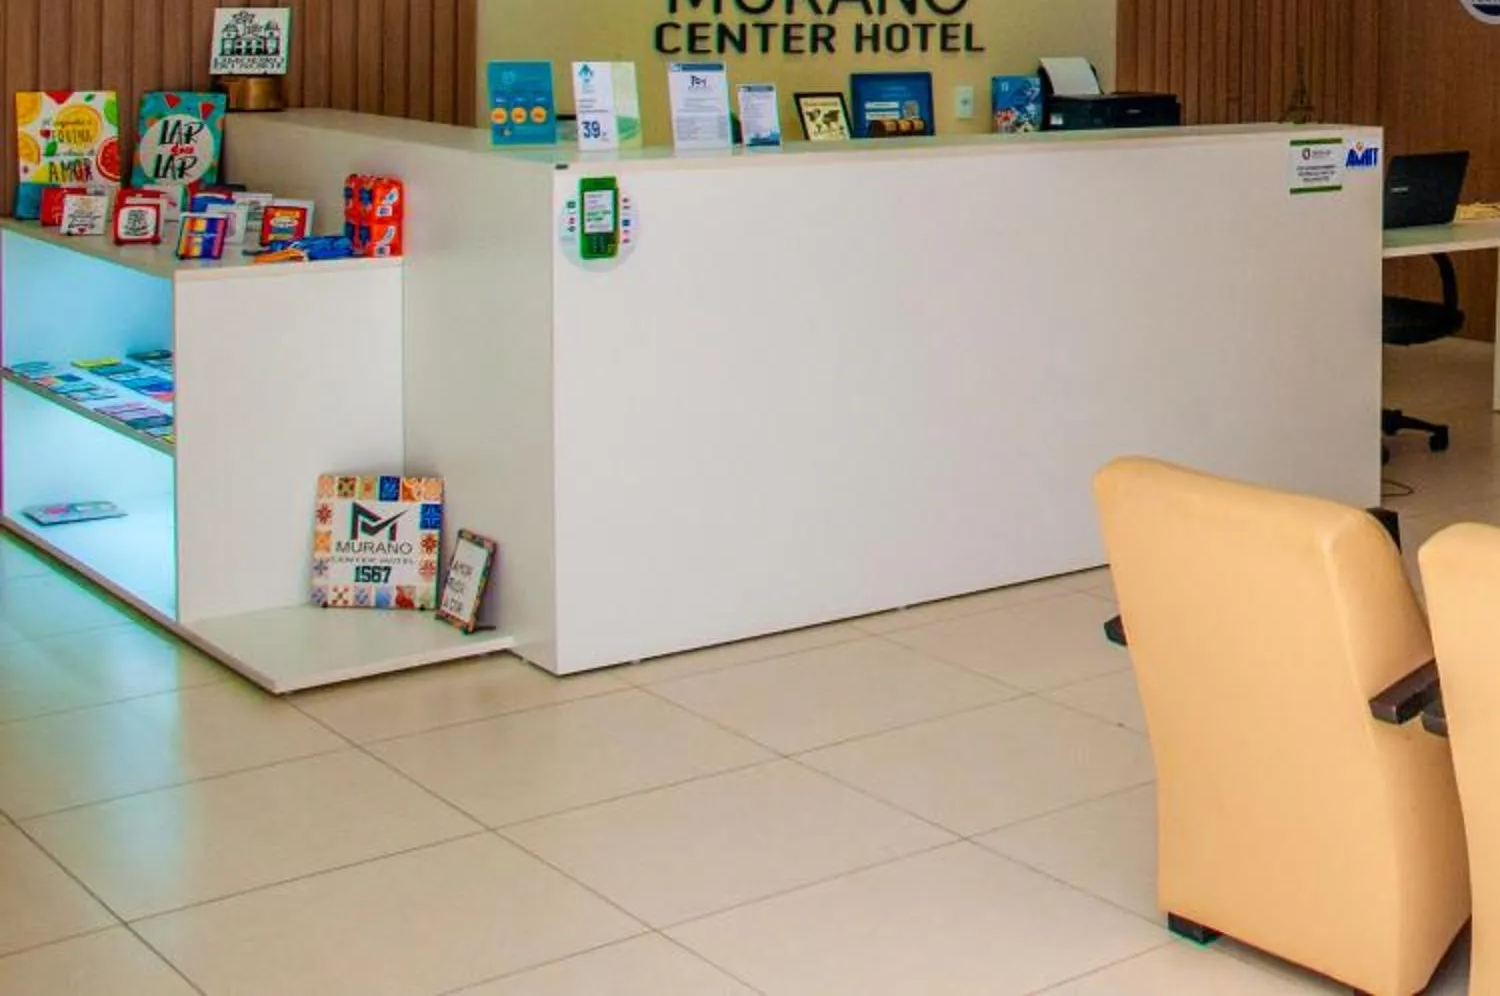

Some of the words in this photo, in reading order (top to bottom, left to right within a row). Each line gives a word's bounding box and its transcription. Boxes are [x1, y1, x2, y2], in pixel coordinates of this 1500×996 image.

[655, 22, 837, 54] CENTER
[855, 22, 986, 53] HOTEL
[159, 119, 205, 145] LAR
[154, 154, 198, 180] LAR
[336, 540, 413, 554] MURANO
[354, 565, 392, 583] 1567
